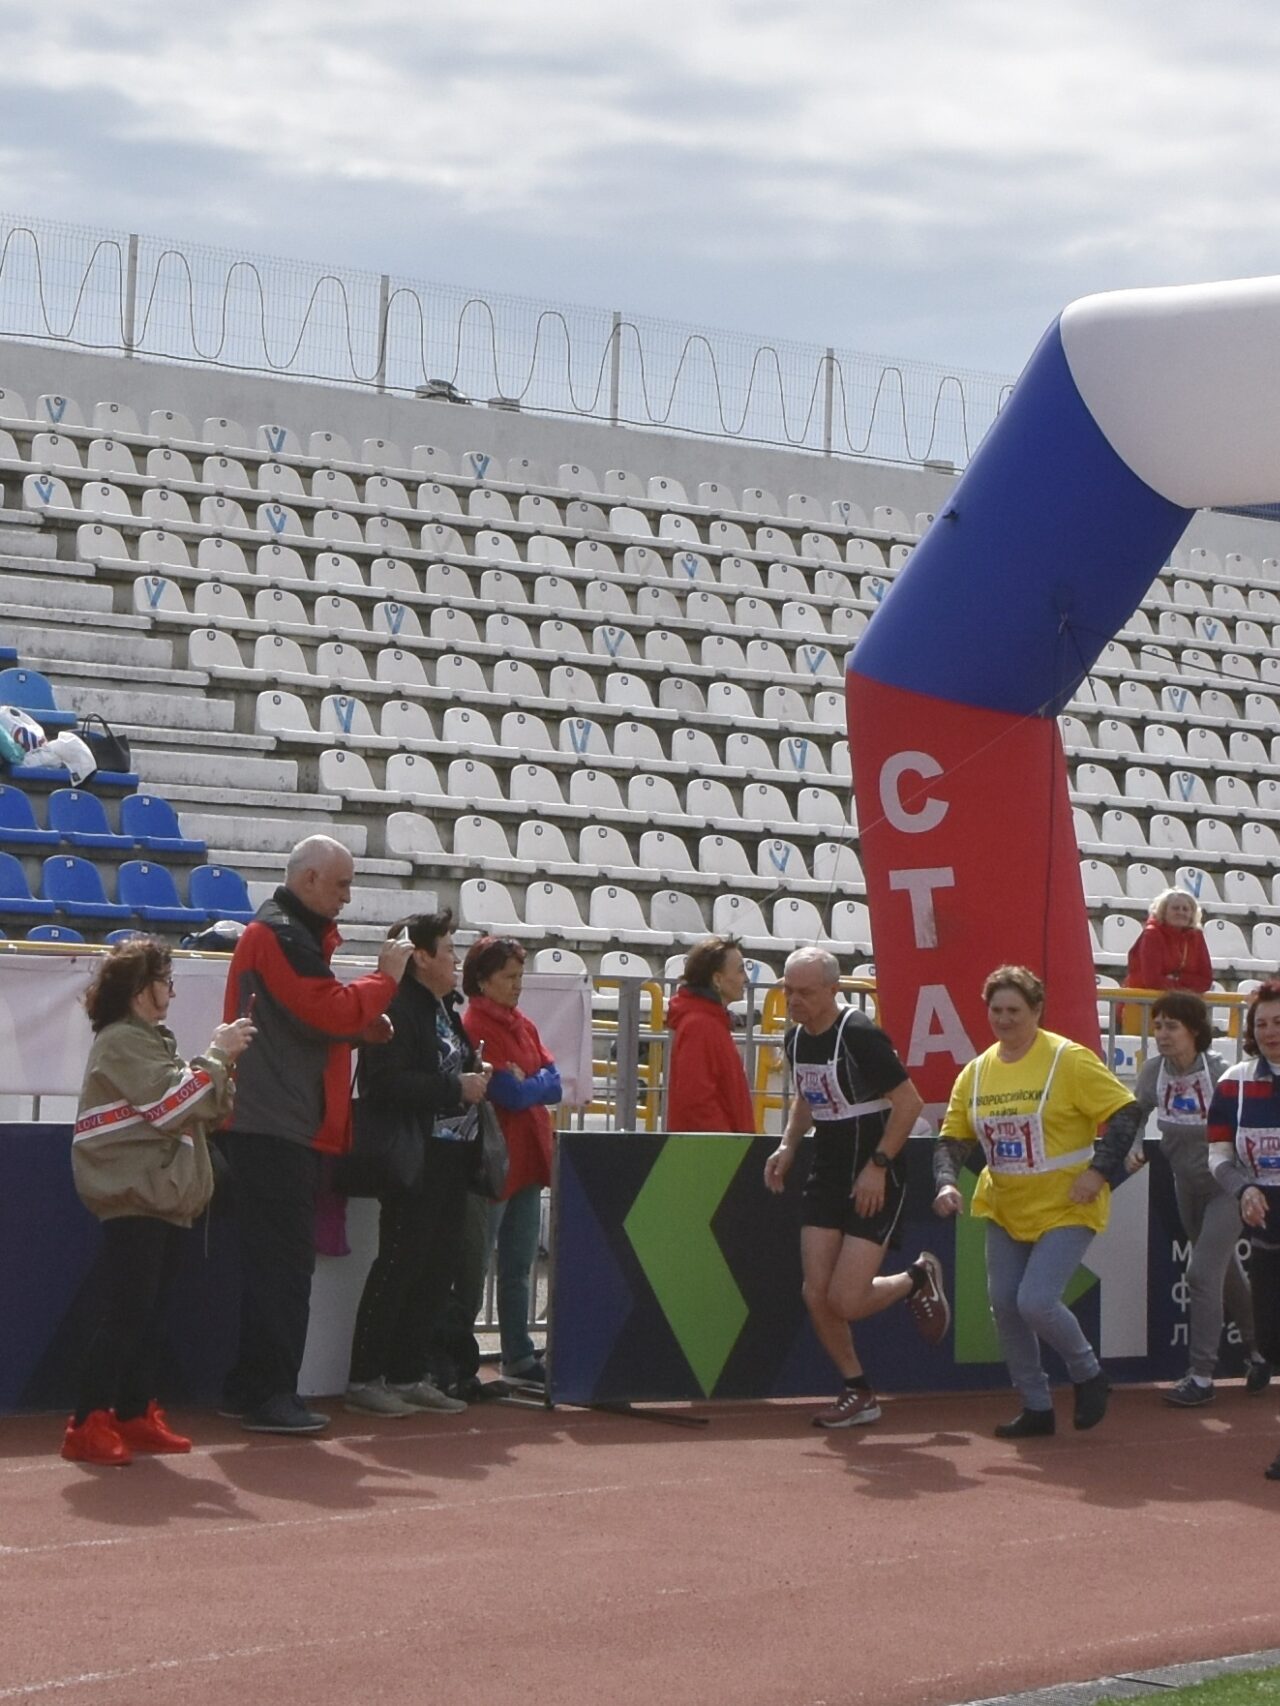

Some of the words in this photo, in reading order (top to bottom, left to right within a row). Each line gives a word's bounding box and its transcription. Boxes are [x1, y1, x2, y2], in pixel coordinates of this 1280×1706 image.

[879, 750, 978, 1121] СТА
[176, 1077, 202, 1103] LOVE
[76, 1112, 104, 1132] LOVE
[115, 1104, 135, 1121] LO
[997, 1121, 1016, 1136] ГТО
[1001, 1142, 1018, 1156] 11
